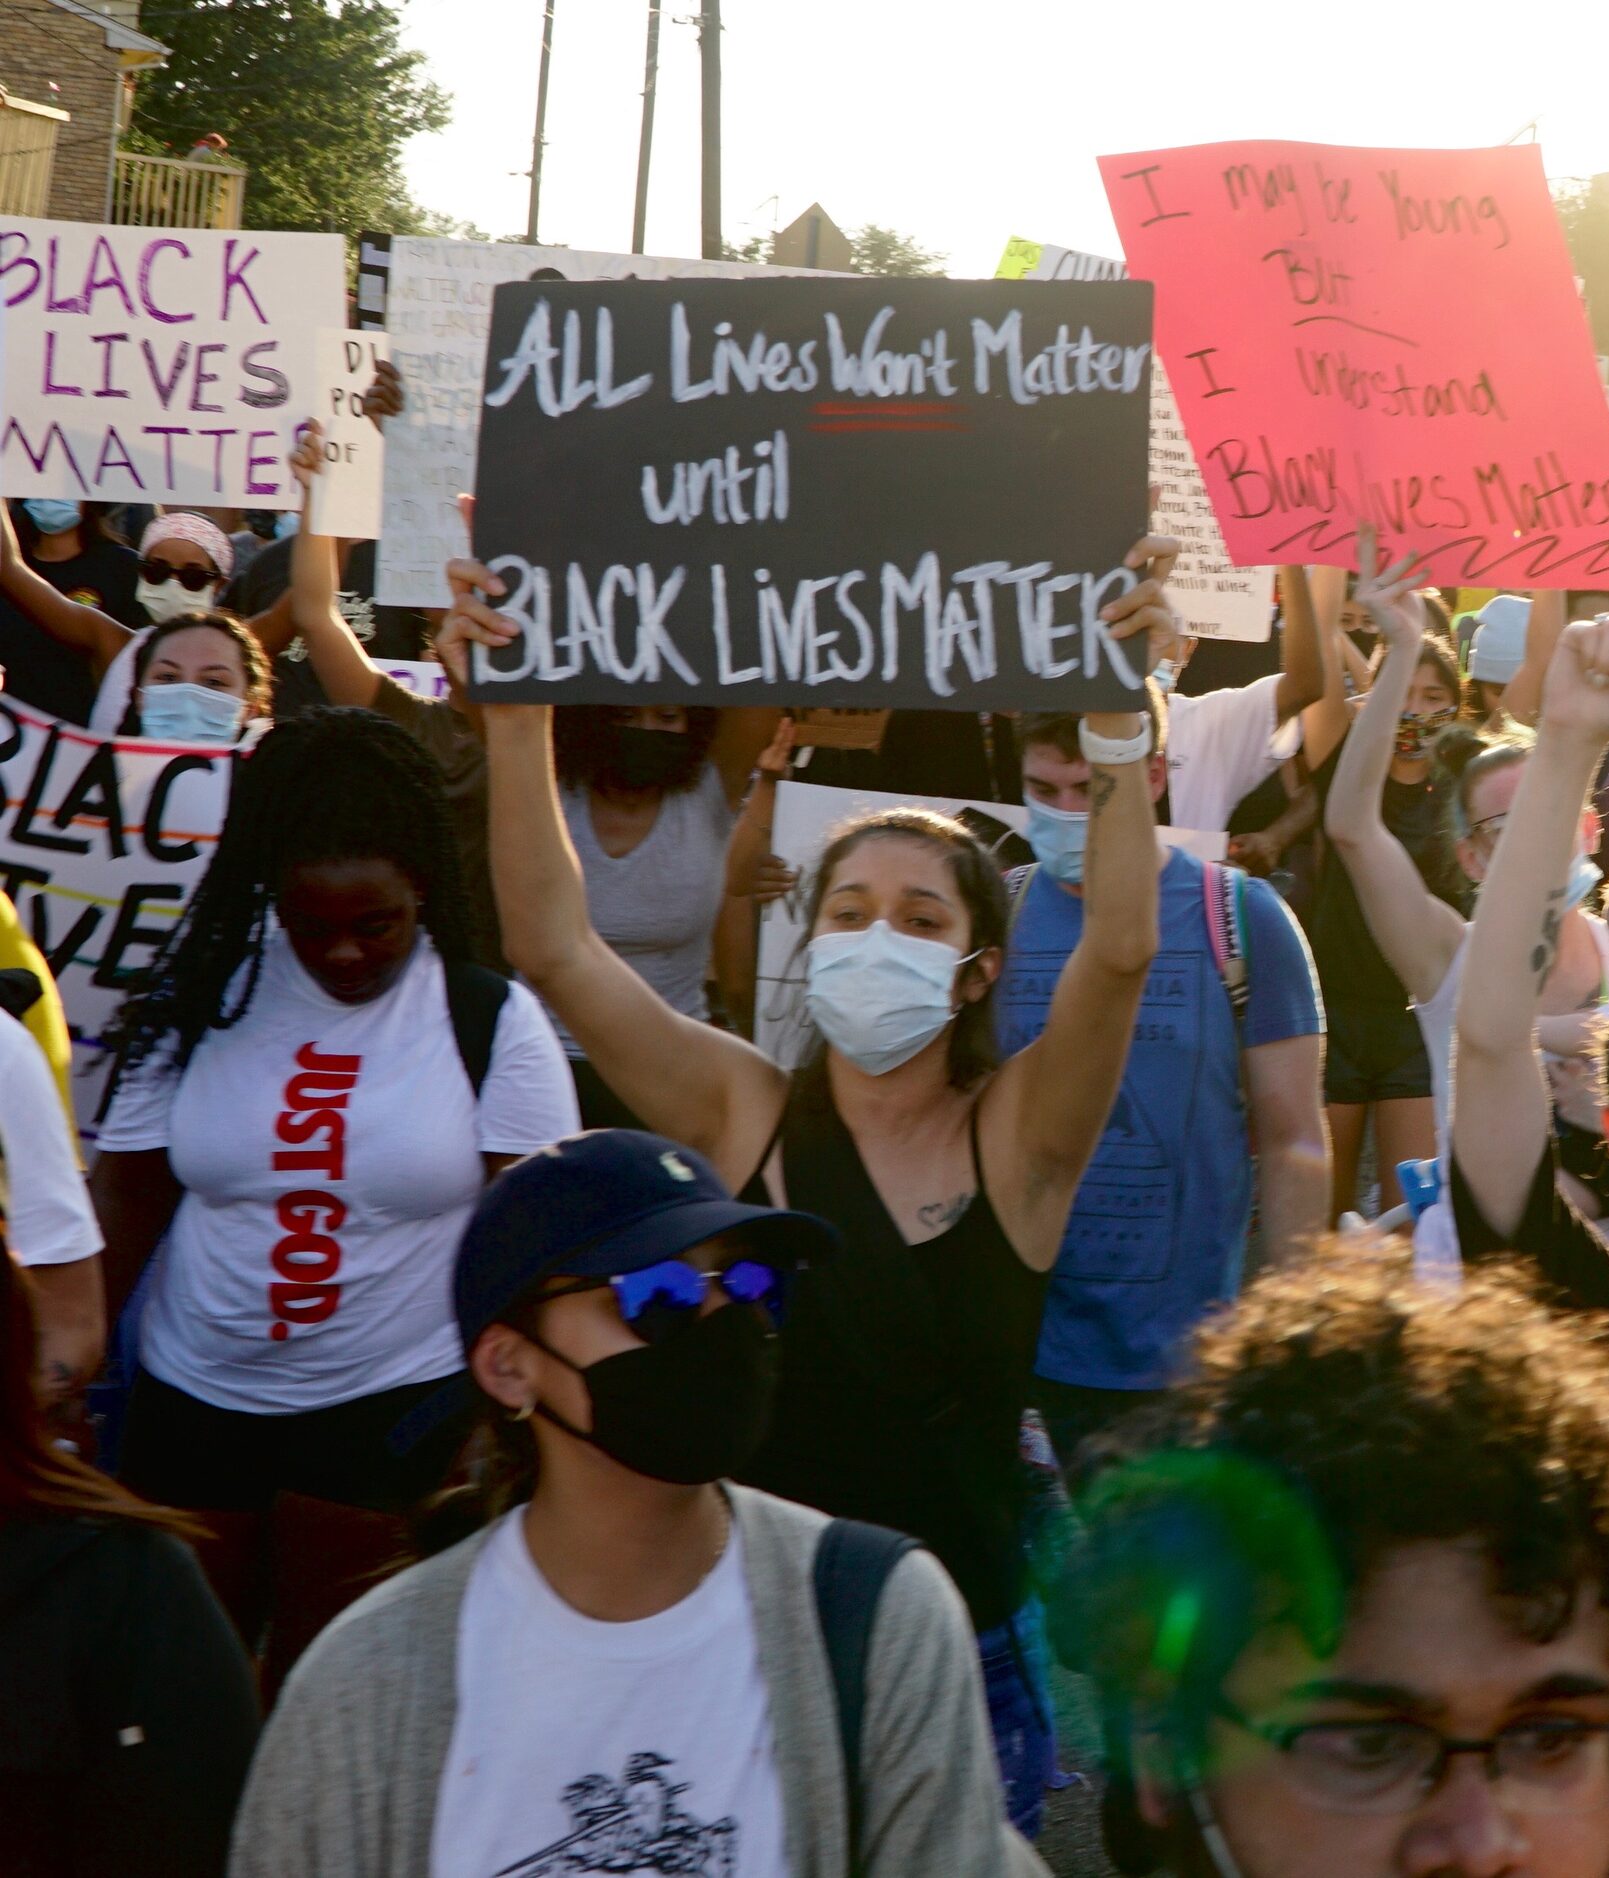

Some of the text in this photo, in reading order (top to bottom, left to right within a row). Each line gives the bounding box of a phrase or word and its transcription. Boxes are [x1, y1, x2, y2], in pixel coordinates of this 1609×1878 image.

[1121, 165, 1191, 229] I
[1378, 167, 1512, 250] Young
[0, 232, 268, 325] BLACK
[43, 330, 291, 413] LIVES
[331, 387, 364, 419] PO
[485, 298, 653, 418] ALL
[825, 305, 957, 397] Won't
[971, 308, 1152, 405] Matter
[1184, 347, 1237, 400] I
[641, 429, 790, 525] until
[1206, 435, 1354, 520] Black
[471, 552, 700, 687] BLACK
[880, 548, 1147, 699] MATTER
[0, 705, 218, 863] LAC
[270, 1040, 364, 1181] JUST
[267, 1188, 349, 1342] GOD.
